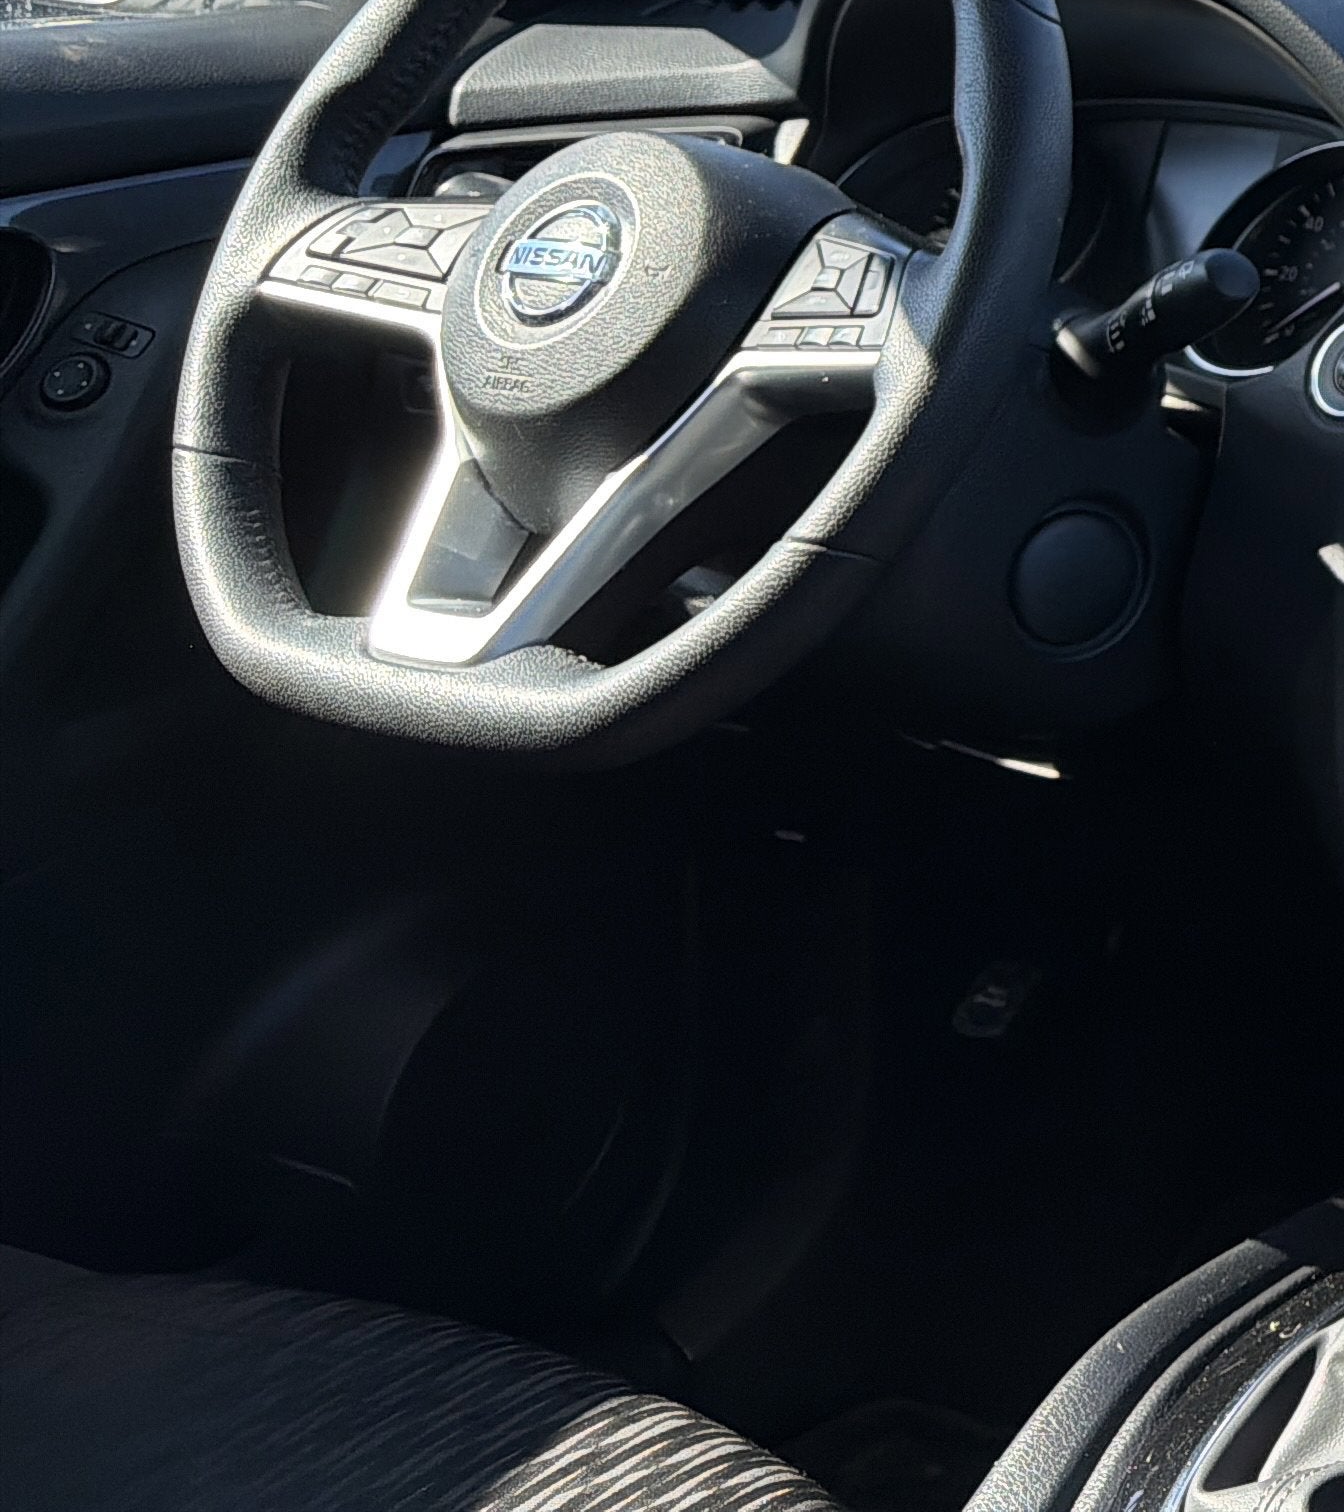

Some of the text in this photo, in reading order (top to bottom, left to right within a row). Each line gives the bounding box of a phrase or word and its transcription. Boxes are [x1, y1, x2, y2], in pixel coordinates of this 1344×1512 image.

[1305, 215, 1325, 233] 40
[509, 246, 608, 275] NISSAN
[1278, 265, 1298, 282] 20
